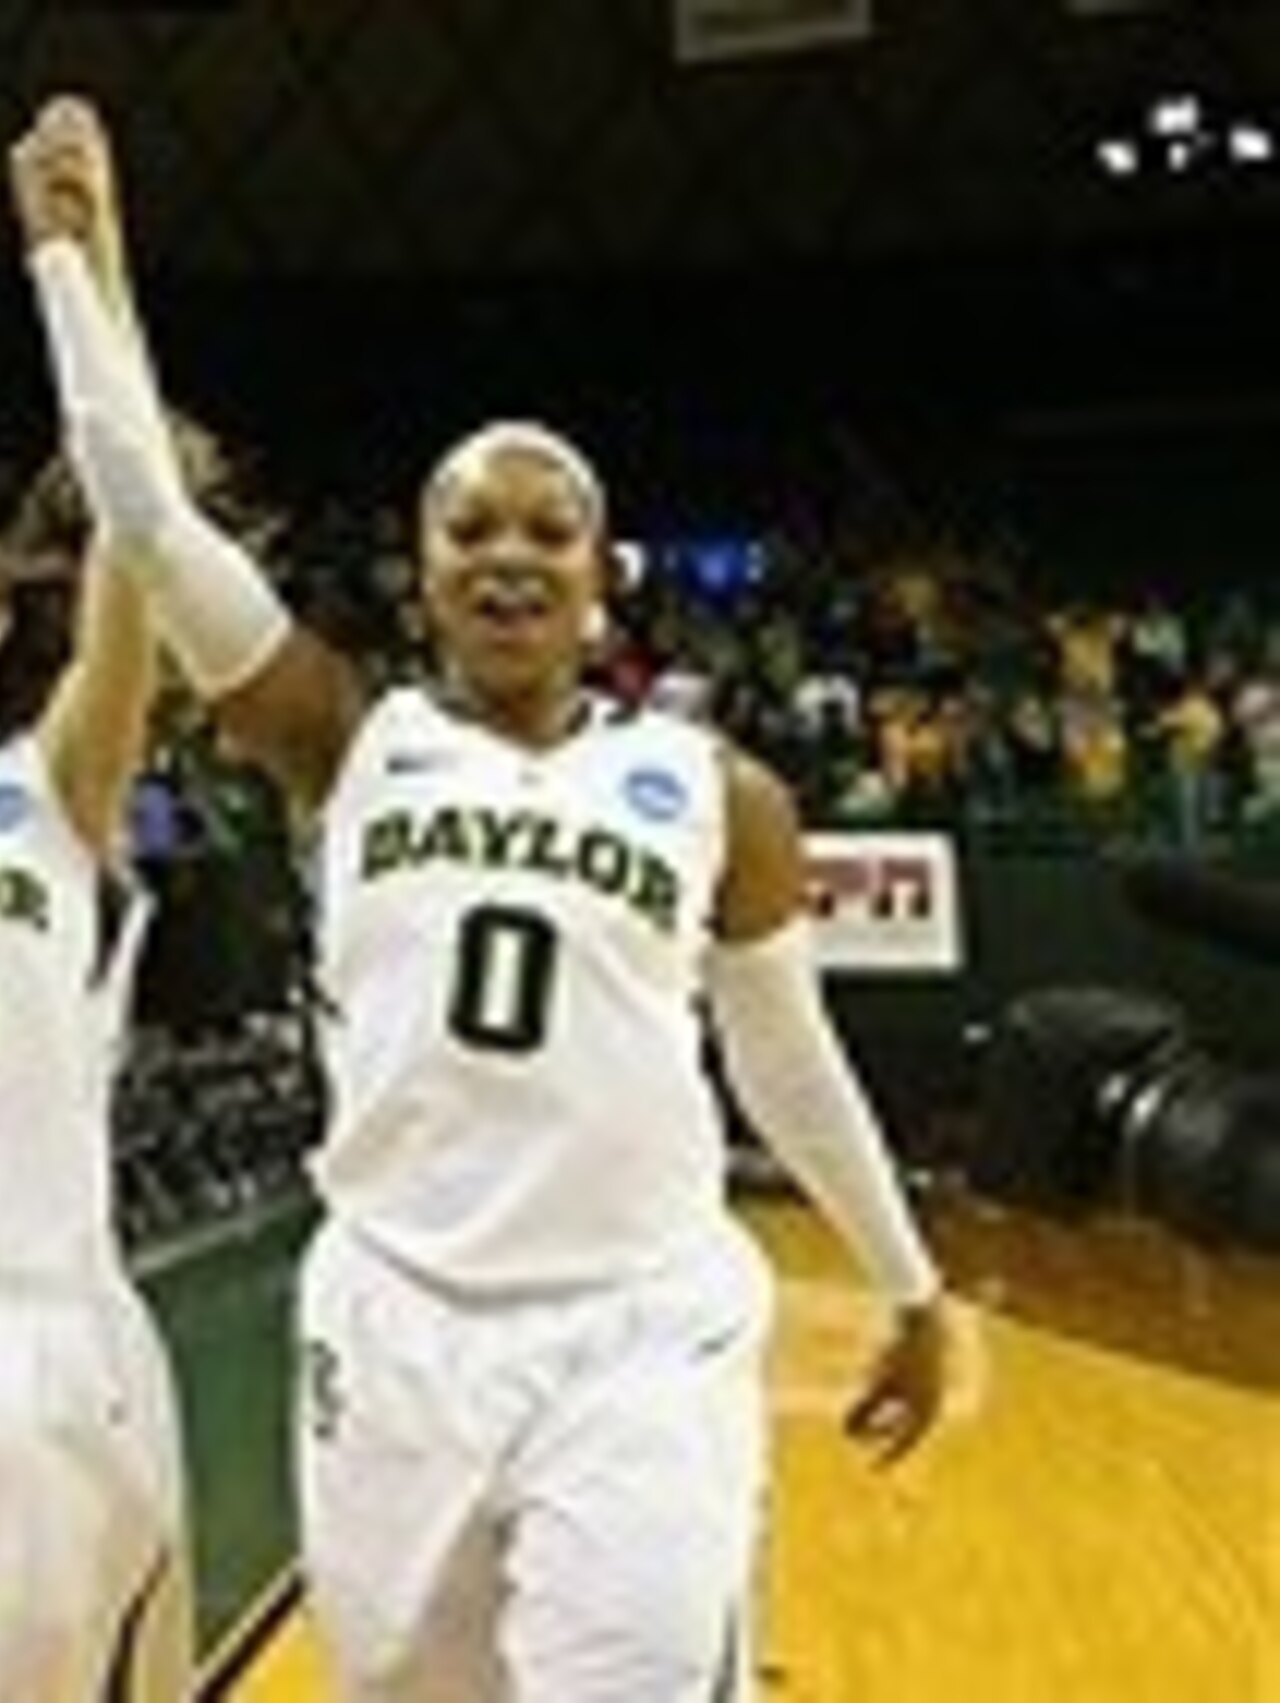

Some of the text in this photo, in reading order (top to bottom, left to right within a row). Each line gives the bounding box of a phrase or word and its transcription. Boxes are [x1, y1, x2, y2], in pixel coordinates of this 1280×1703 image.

[361, 806, 677, 932] BAYLOR
[810, 858, 933, 922] PN
[447, 903, 558, 1054] 0
